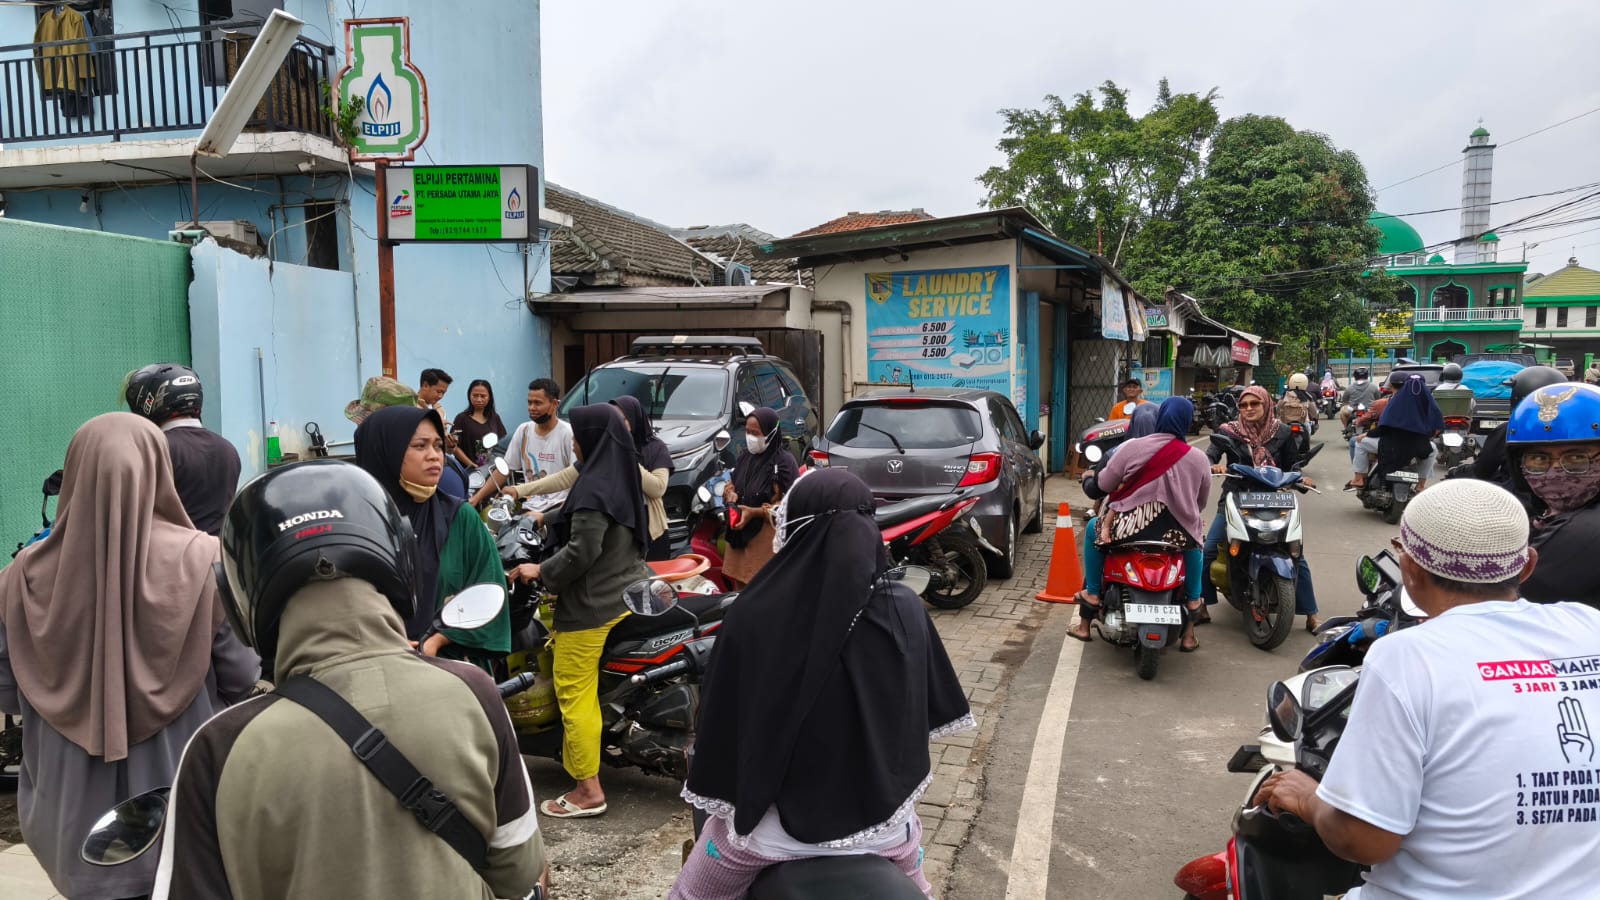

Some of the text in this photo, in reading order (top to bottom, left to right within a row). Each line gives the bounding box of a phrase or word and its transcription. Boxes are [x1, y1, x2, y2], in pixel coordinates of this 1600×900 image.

[364, 123, 399, 136] ELPIJI
[415, 172, 498, 185] ELPIJI PERTAMINA
[416, 190, 499, 199] PT. PERSADA UTAMA JAYA
[902, 270, 997, 297] LAUNDRY
[908, 293, 993, 319] SERVICE
[922, 321, 947, 333] 6.500
[922, 334, 947, 346] 5.000
[922, 347, 947, 358] 4.500
[1099, 427, 1125, 438] POLISI
[278, 509, 344, 531] HONDA
[1480, 663, 1554, 678] GANJAR
[1512, 683, 1522, 693] 3
[1526, 682, 1557, 693] JARI
[1559, 681, 1569, 692] 3
[1516, 772, 1526, 788] 1.
[1531, 771, 1559, 787] TAAT
[1563, 769, 1593, 786] PADA
[1516, 788, 1600, 807] 2. PATUH PADA
[1516, 807, 1597, 825] 3. SETIA PADA
